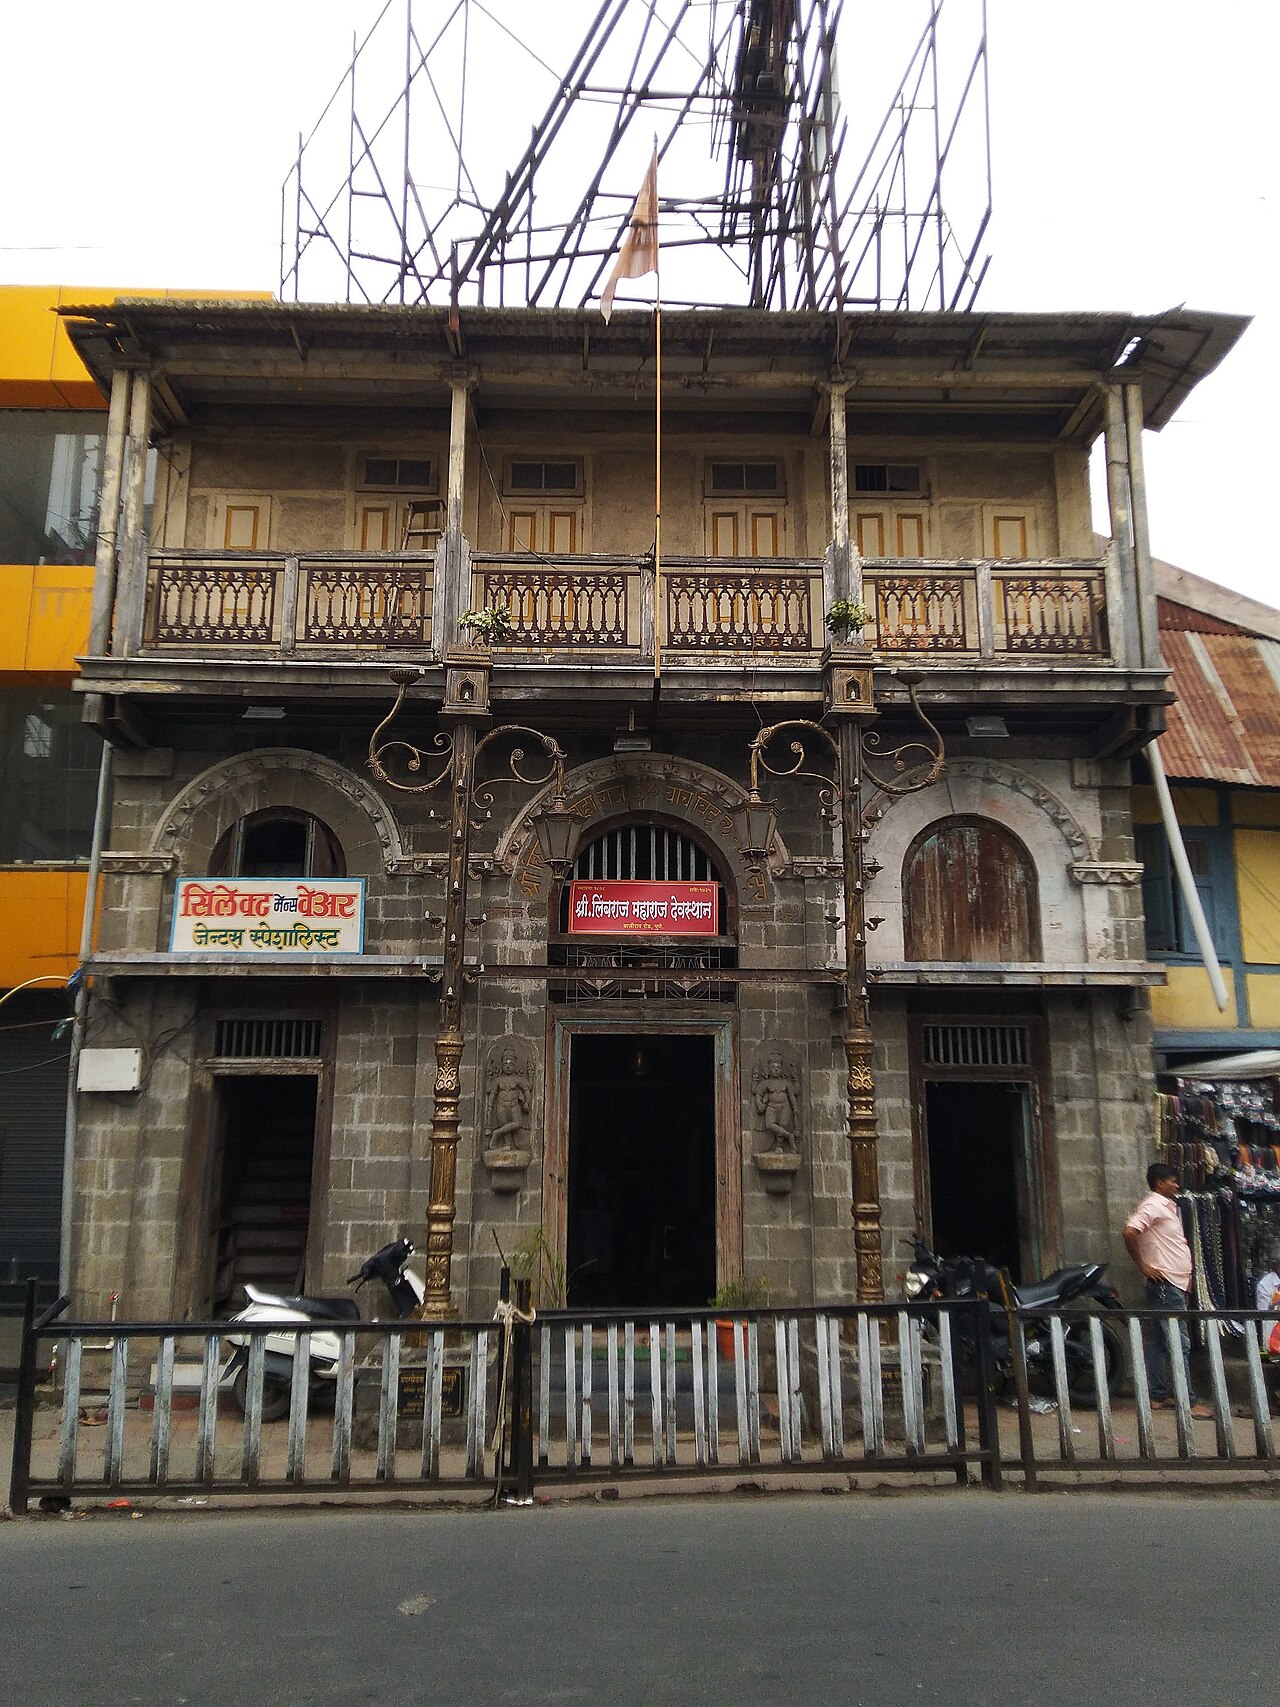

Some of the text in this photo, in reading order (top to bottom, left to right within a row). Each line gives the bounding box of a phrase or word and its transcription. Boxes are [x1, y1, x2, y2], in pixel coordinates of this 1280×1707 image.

[180, 884, 273, 917] सिलेक्ट
[297, 885, 357, 918] वेअर
[632, 901, 669, 920] महाराज
[671, 895, 712, 921] देवस्थान
[250, 921, 341, 950] स्पेशालिस्ट
